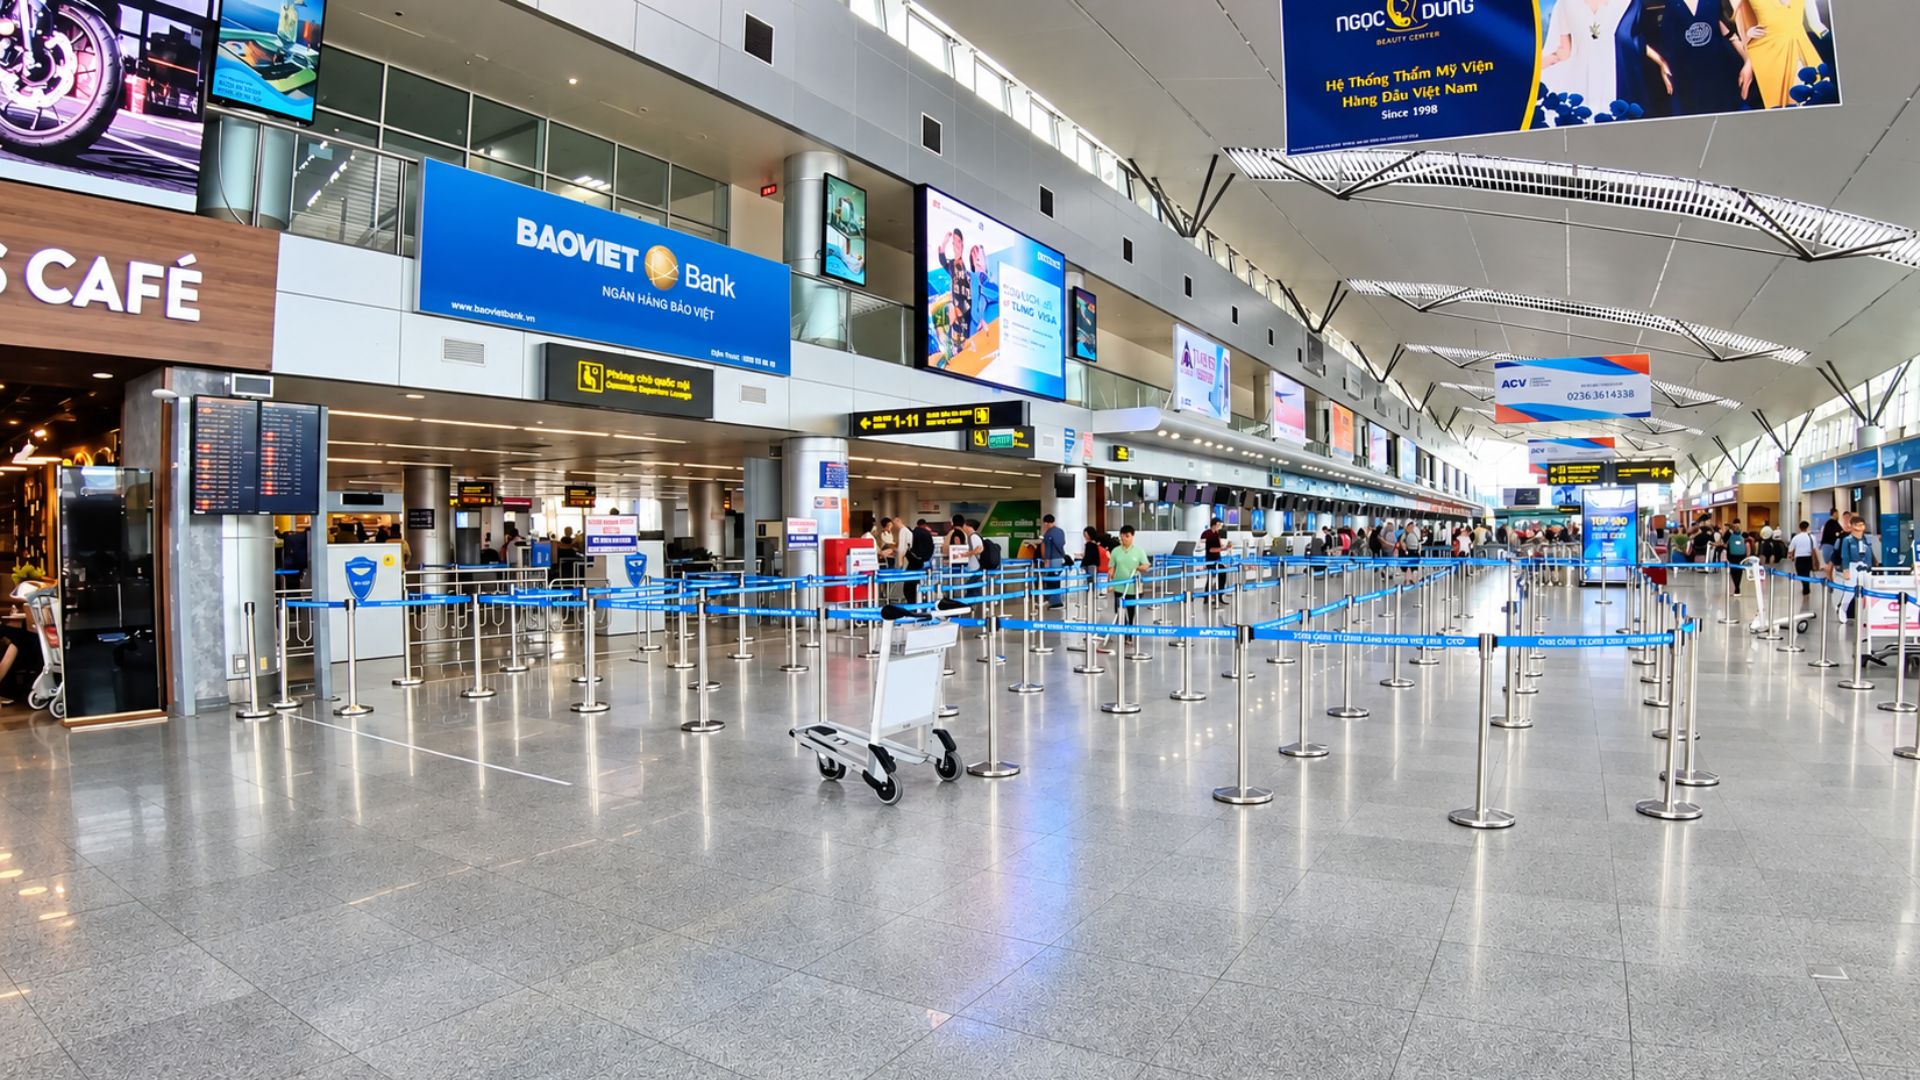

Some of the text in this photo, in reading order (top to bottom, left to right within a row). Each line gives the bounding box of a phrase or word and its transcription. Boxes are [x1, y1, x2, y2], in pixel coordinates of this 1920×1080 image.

[1336, 10, 1385, 32] NGỌC
[1376, 31, 1440, 46] BEAUTY CENTER
[1326, 79, 1344, 93] Hệ
[1436, 63, 1457, 78] Mỹ
[1461, 60, 1494, 75] Viện
[1412, 86, 1441, 100] Việt
[1445, 82, 1478, 95] Nam
[1381, 104, 1438, 120] Since 1998
[516, 217, 736, 299] BAOVIET Bank
[24, 248, 203, 322] CAFÉ
[451, 302, 536, 323] www.baovietbank.vn
[1502, 378, 1527, 389] ACV
[893, 414, 919, 428] 1-11
